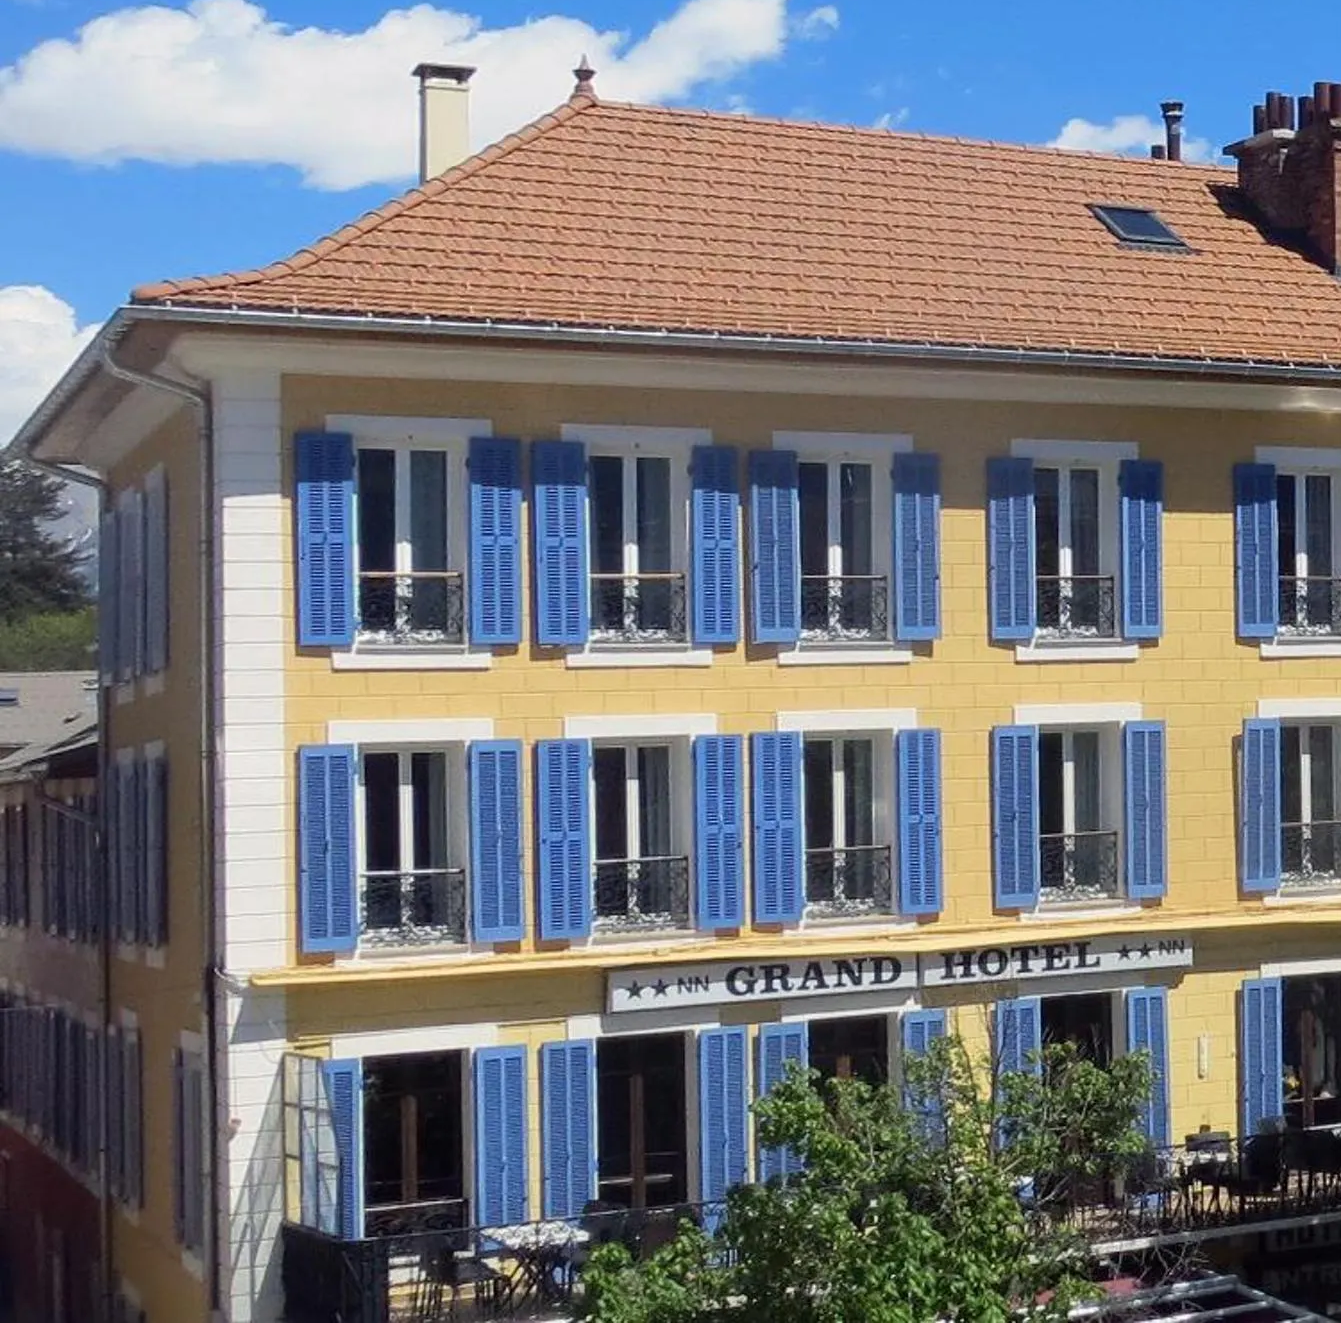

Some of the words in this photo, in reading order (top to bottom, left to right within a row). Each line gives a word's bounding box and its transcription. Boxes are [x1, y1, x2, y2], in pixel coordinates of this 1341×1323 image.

[676, 975, 710, 994] NN
[725, 955, 902, 997] GRAND
[939, 940, 1101, 980] HOTEL
[1158, 939, 1186, 955] NN
